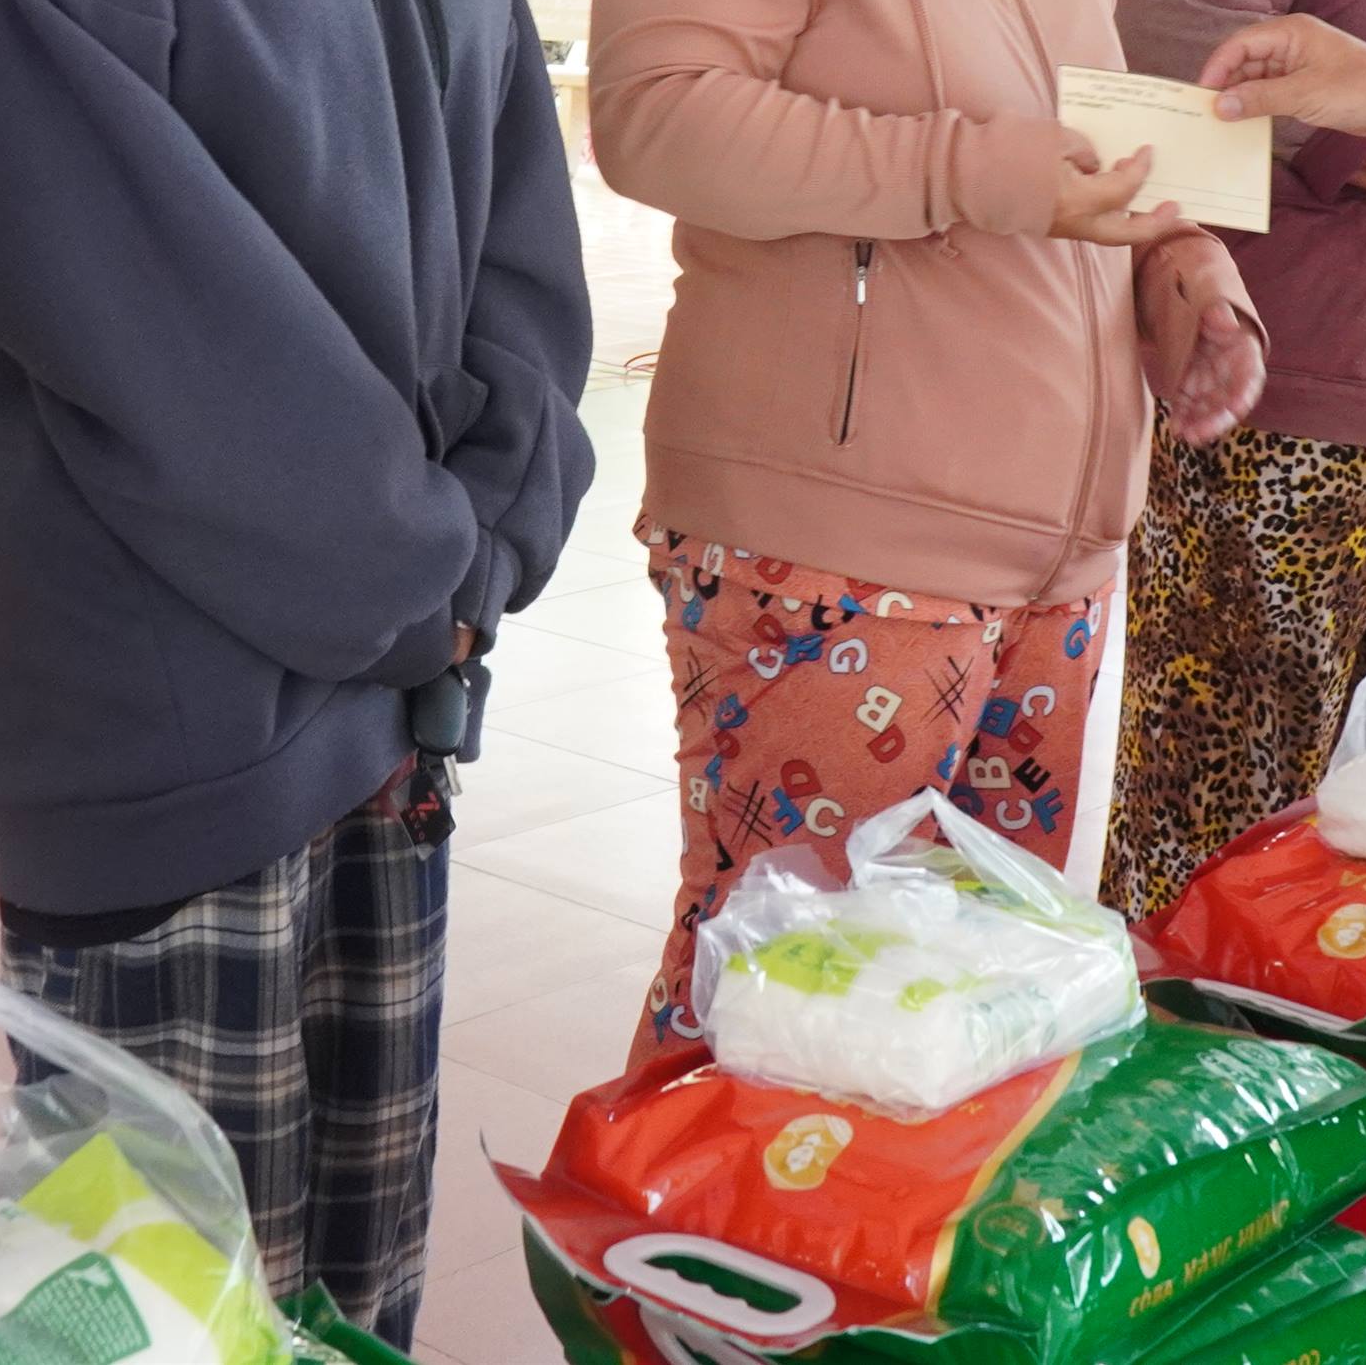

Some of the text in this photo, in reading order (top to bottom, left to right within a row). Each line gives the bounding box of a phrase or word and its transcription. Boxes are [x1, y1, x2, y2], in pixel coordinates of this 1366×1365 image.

[828, 638, 869, 675] G
[855, 684, 904, 735] B
[1021, 685, 1056, 717] C
[866, 722, 906, 764] D
[780, 759, 824, 799] D
[967, 756, 1013, 789] B
[1013, 757, 1051, 794] E
[771, 786, 805, 837] F
[804, 797, 846, 838] C
[995, 798, 1033, 831] C
[1030, 787, 1065, 834] F
